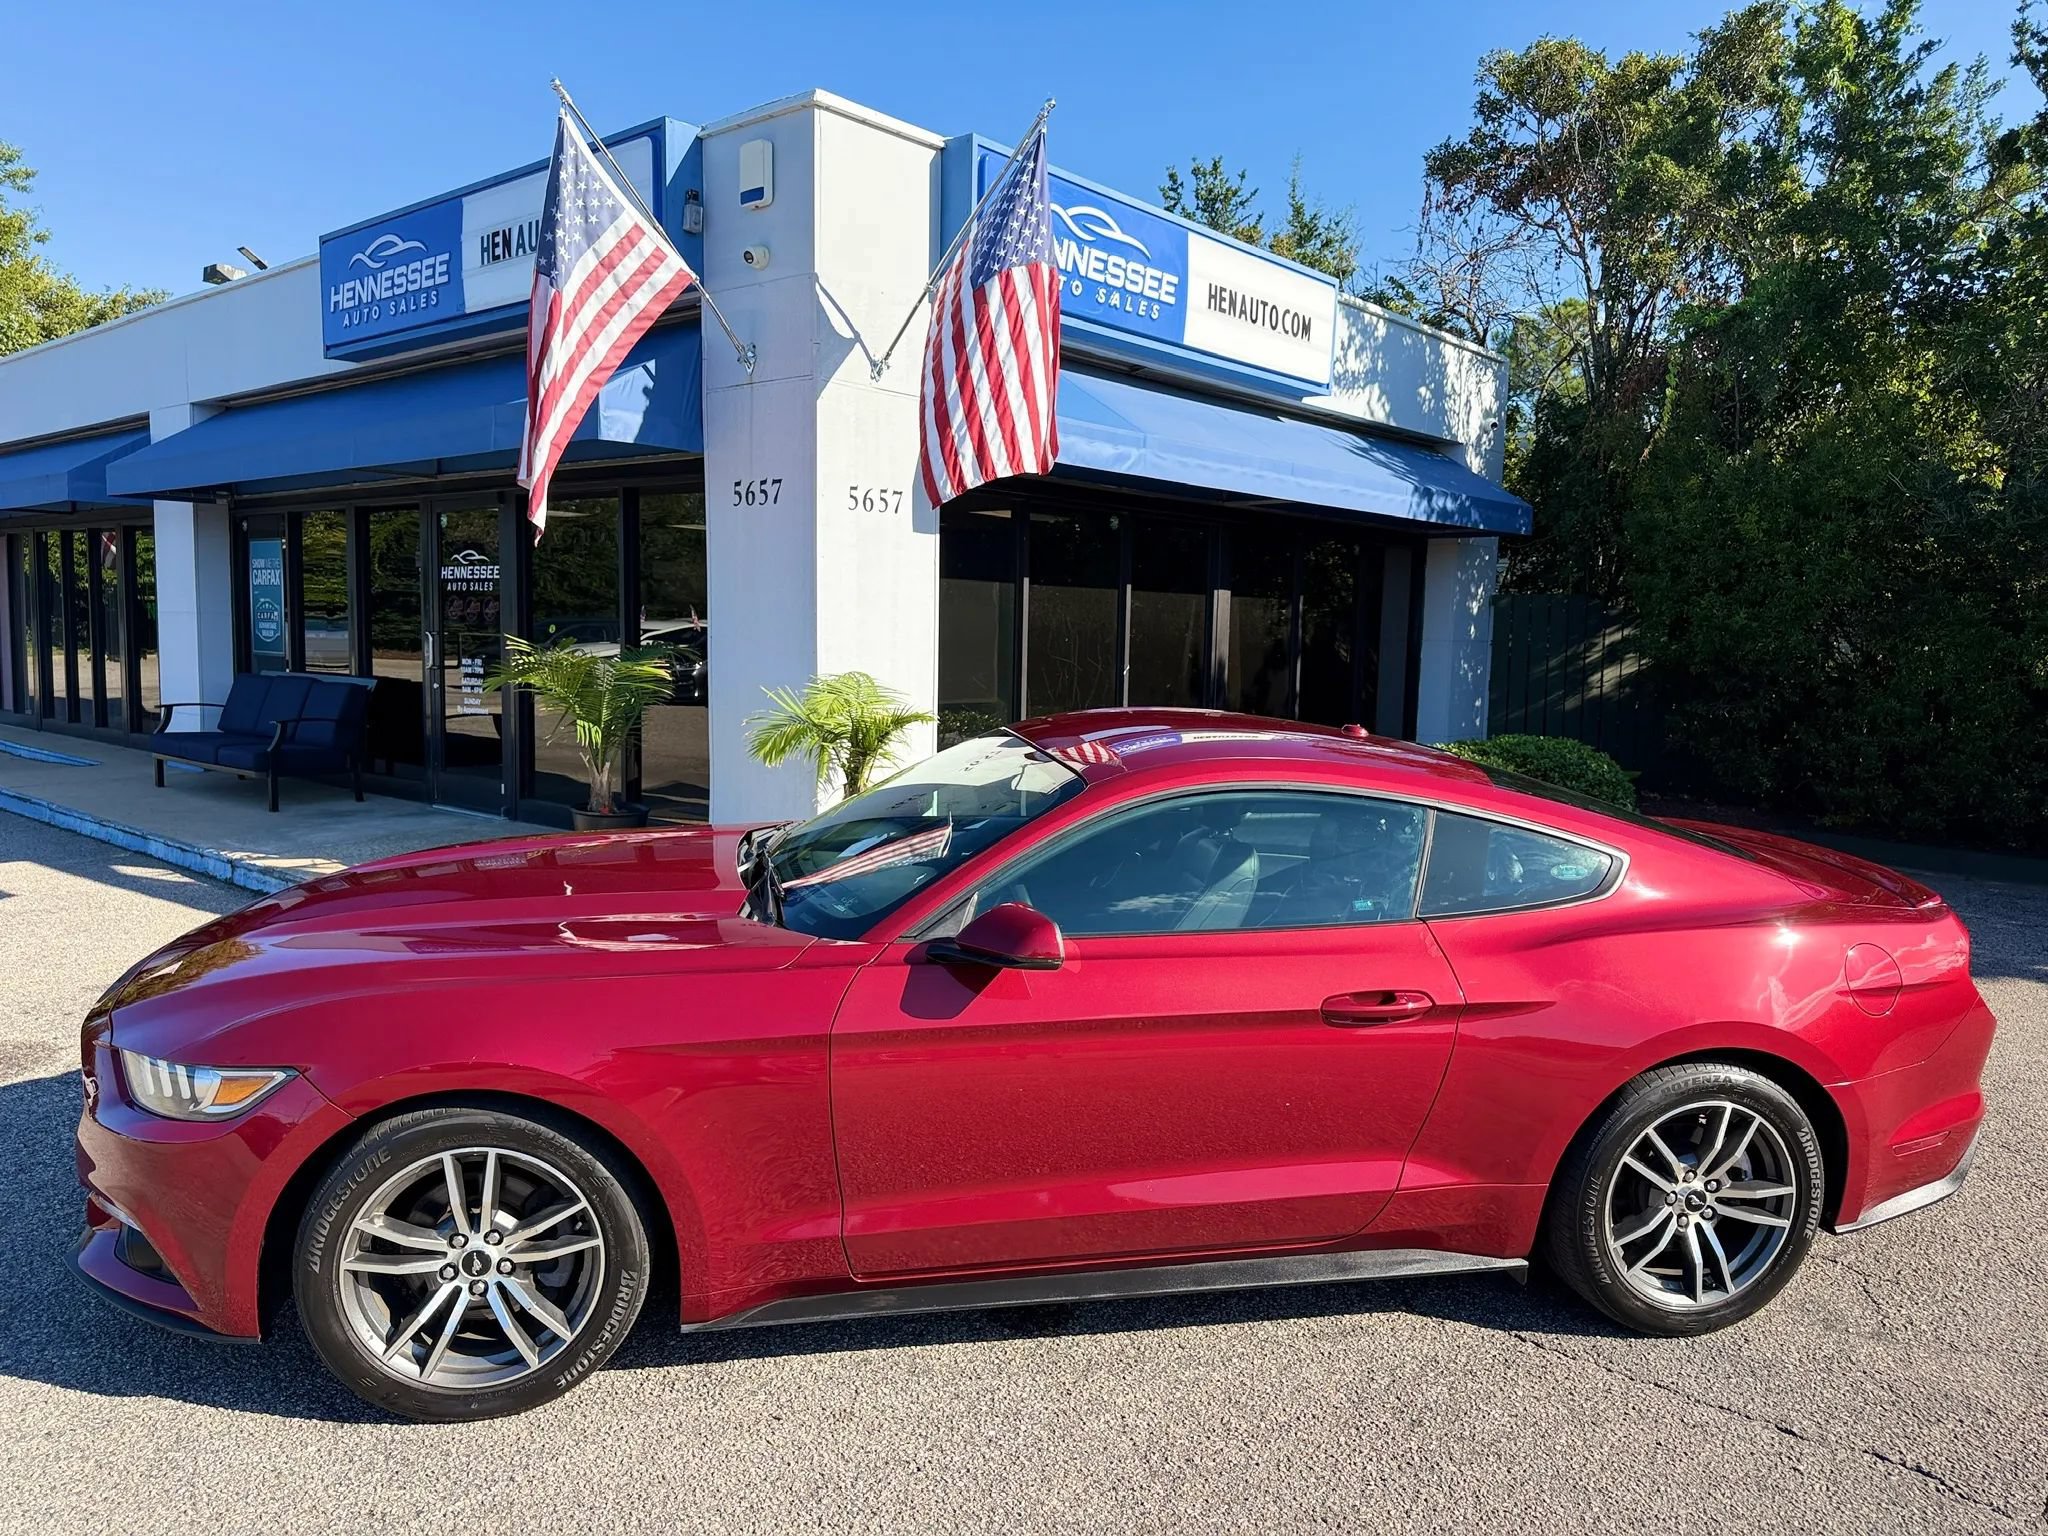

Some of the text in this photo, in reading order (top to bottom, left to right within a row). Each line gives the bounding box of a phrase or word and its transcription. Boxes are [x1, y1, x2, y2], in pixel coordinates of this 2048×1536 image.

[481, 219, 540, 265] HENAU
[330, 252, 450, 313] HENNESSEE
[1053, 234, 1179, 305] NNESSEE
[343, 290, 437, 328] AUTO SALES
[1059, 275, 1160, 320] TO SALES
[733, 477, 783, 507] 5657
[848, 485, 903, 514] 5657
[252, 569, 281, 585] CARFAX
[441, 565, 500, 579] HENNESSEE
[447, 582, 493, 591] AUTO SALES
[1796, 1126, 1821, 1240] BRIDGESTONE
[304, 1145, 392, 1274] BRIDGESTONE
[553, 1269, 639, 1389] BRIDGESTONE
